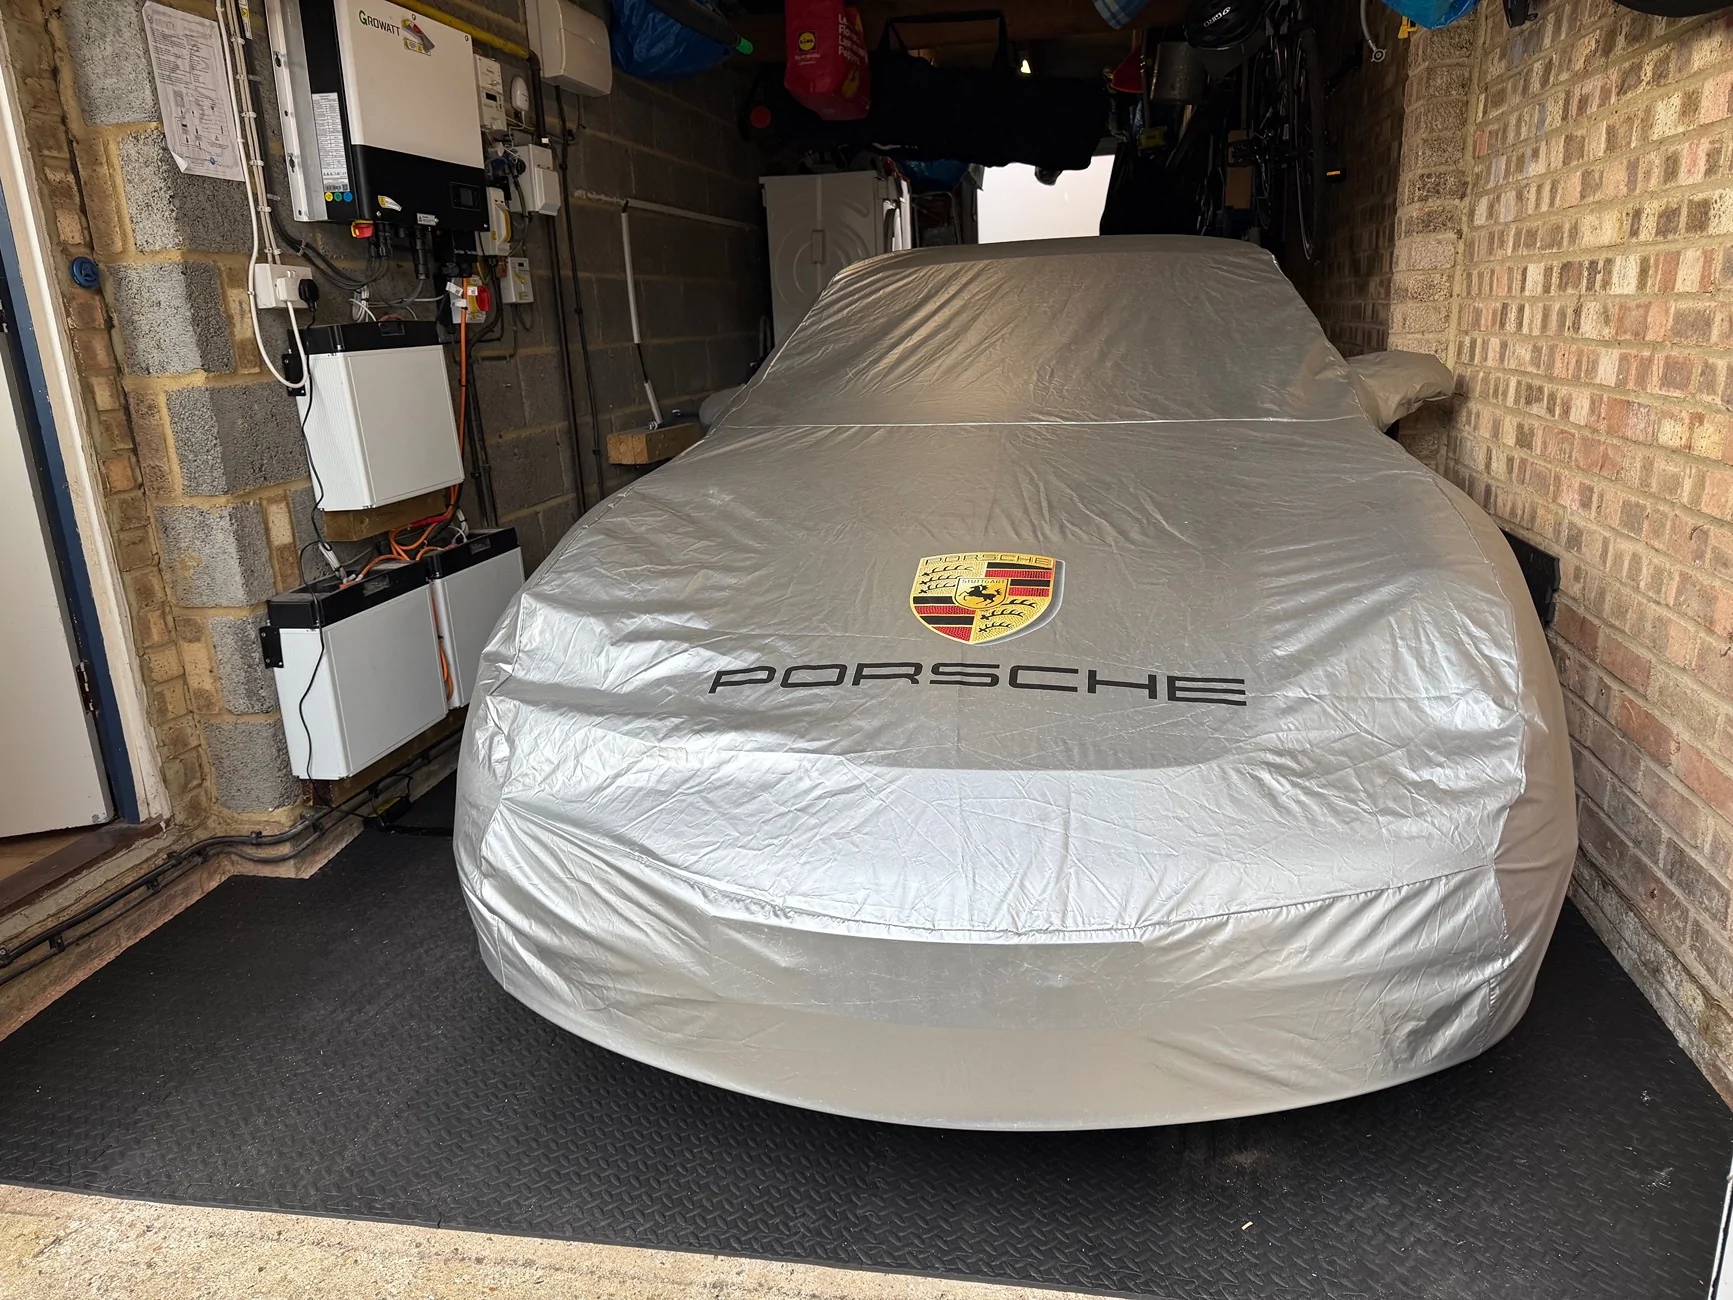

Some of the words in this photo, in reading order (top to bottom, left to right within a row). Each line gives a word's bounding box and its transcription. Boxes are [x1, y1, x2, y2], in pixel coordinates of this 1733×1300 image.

[358, 10, 400, 36] GROWATT
[925, 553, 1052, 566] PORSCHE
[708, 661, 1247, 707] PORSCHE
